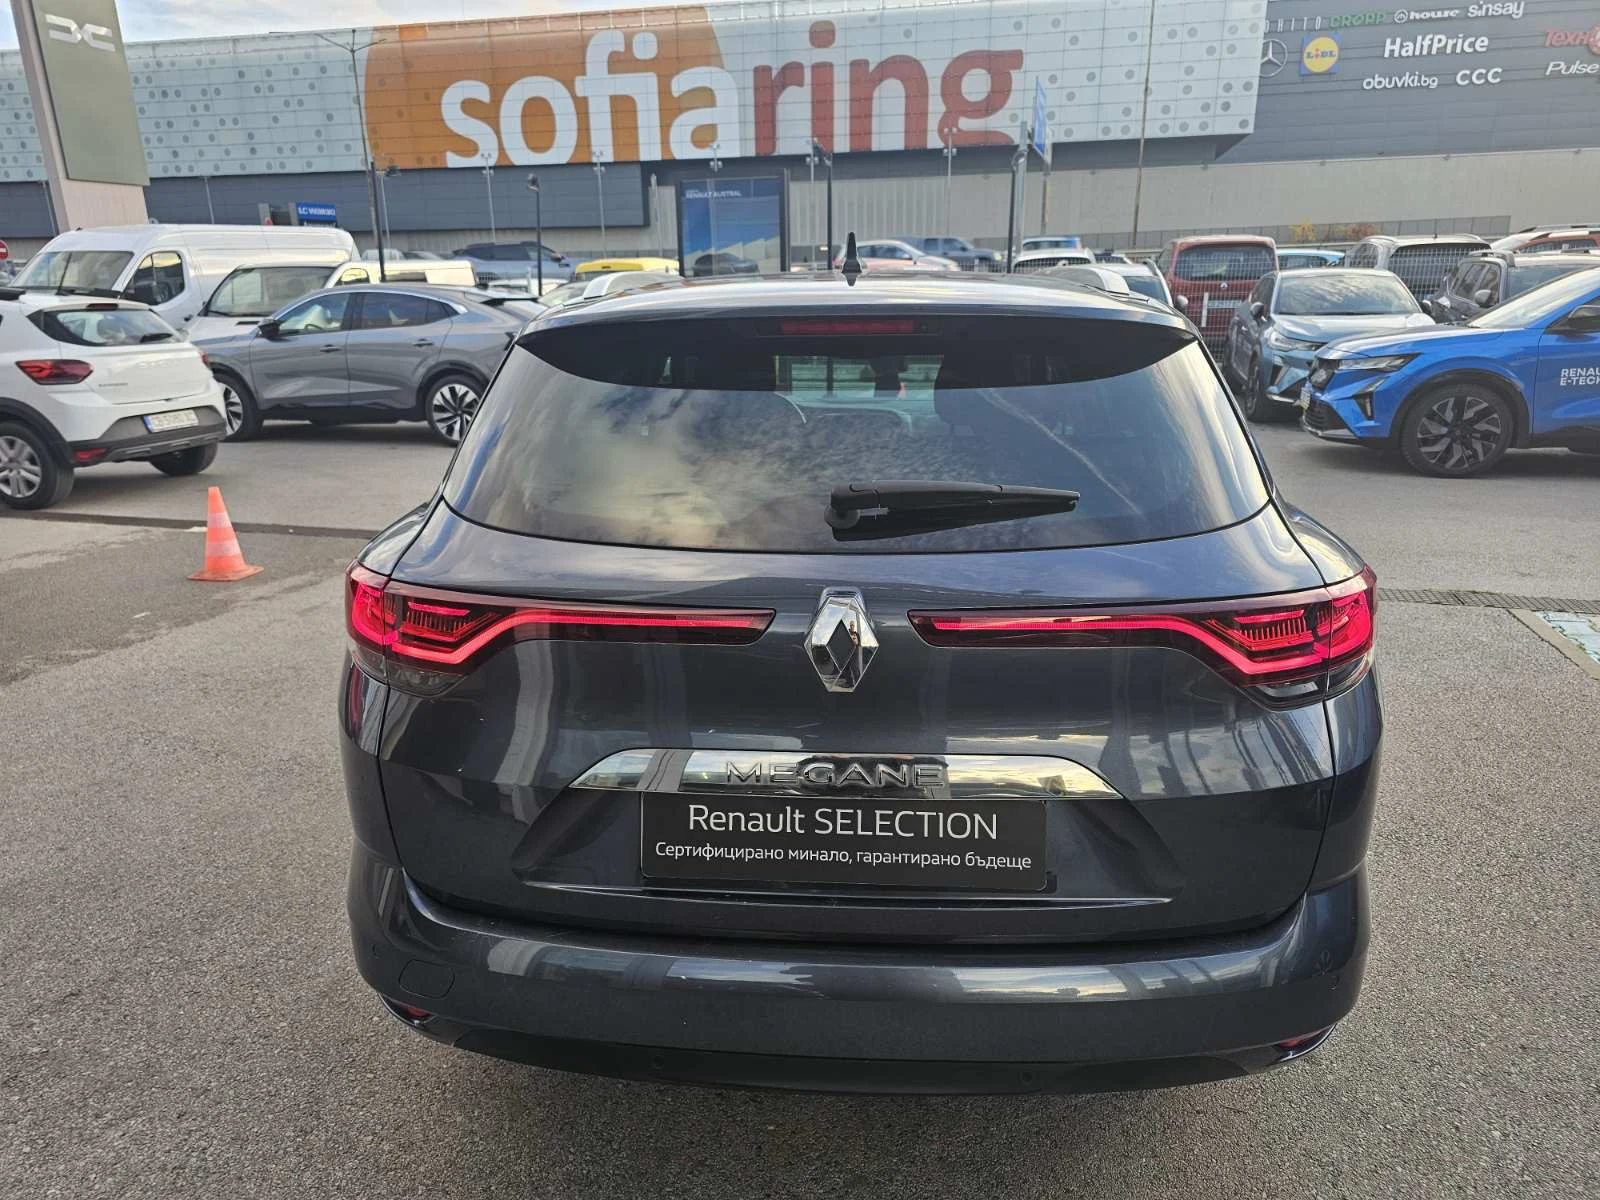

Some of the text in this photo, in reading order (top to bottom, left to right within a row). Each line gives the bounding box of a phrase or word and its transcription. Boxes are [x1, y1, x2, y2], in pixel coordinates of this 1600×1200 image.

[1467, 1, 1525, 19] sinsay
[1328, 12, 1385, 28] CROPP
[1383, 34, 1489, 58] HalfPrice
[1455, 67, 1502, 86] CCC
[1545, 60, 1600, 76] Pulse
[1363, 72, 1438, 89] obuvki.bg
[726, 761, 945, 788] MEGANE
[688, 804, 997, 840] Renault SELECTION
[655, 842, 1032, 871] Сертифицирано минало, гарантирано бъдеще
